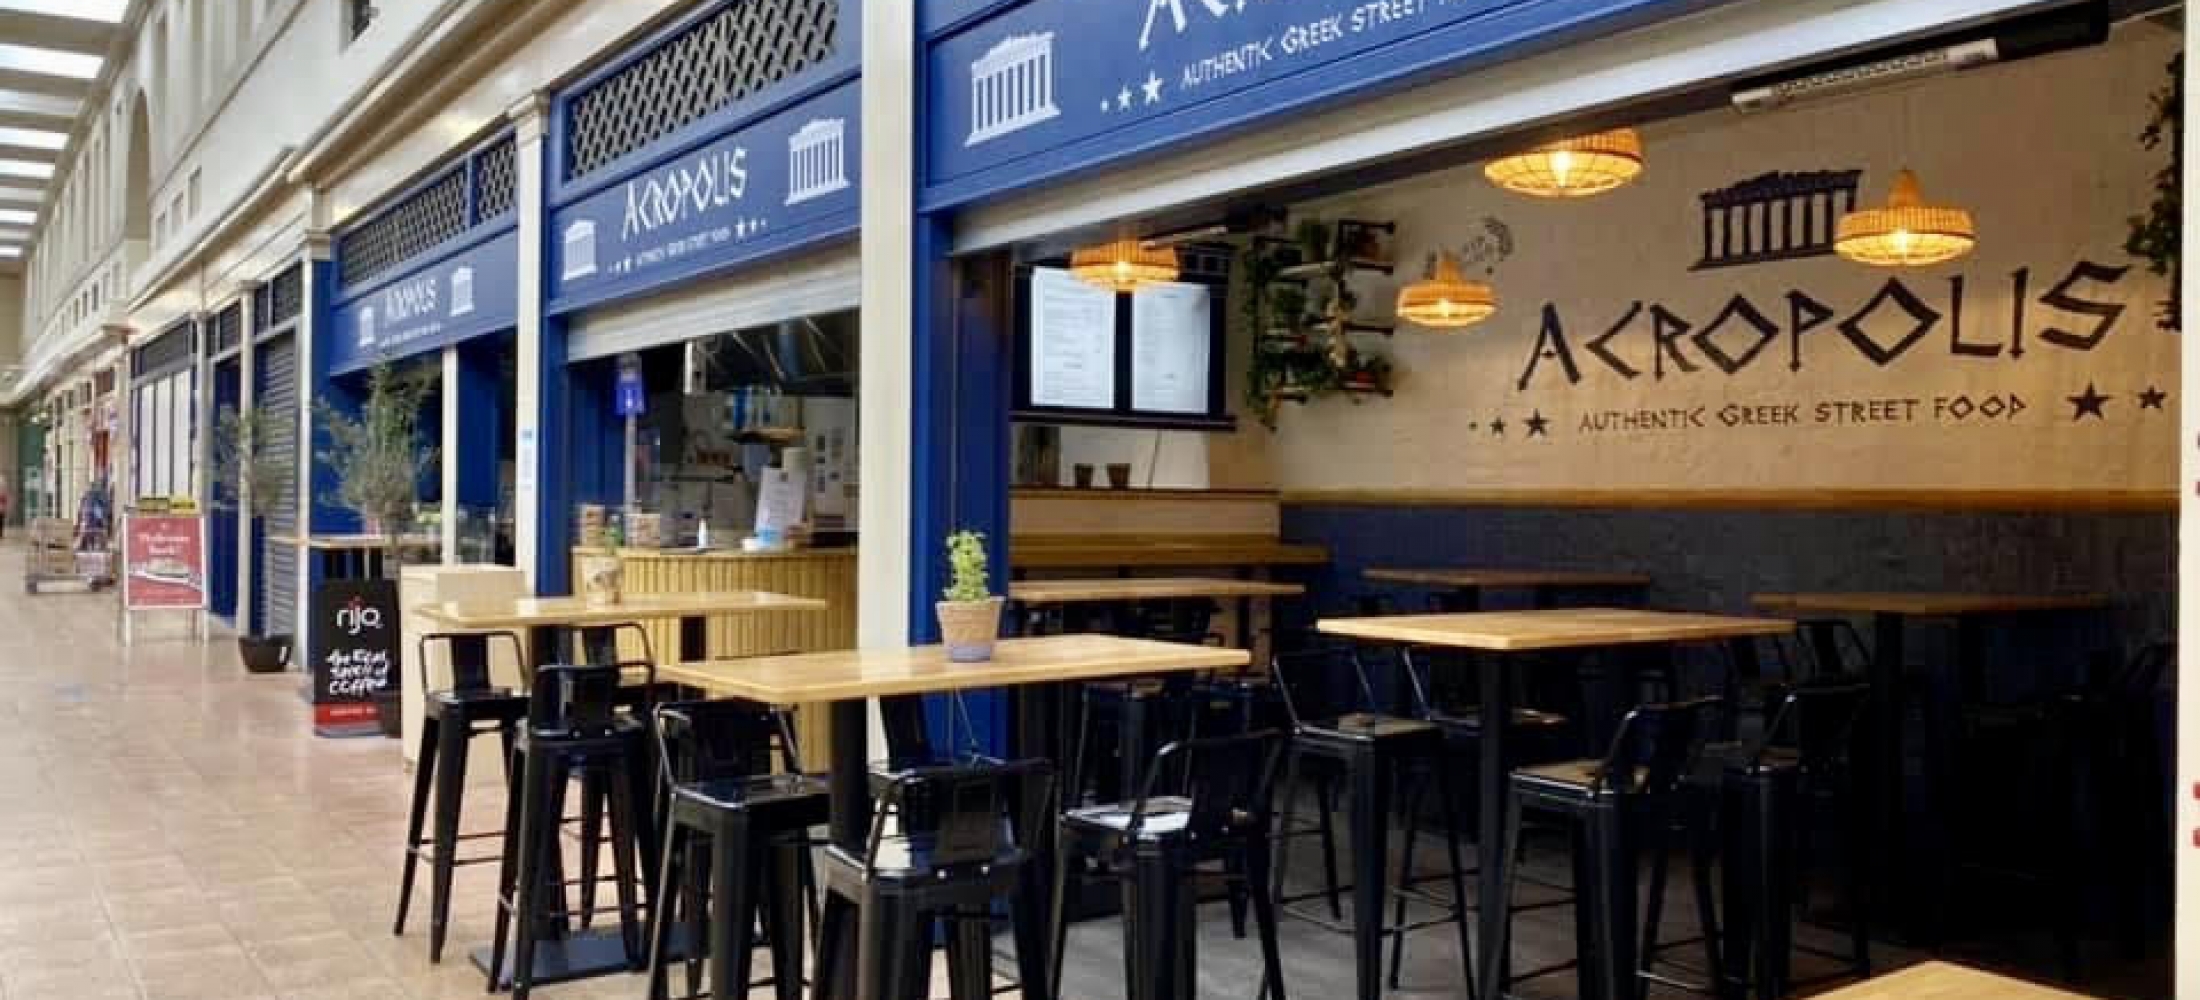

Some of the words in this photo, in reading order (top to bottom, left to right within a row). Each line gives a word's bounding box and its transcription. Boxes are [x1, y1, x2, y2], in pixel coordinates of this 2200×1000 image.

[1180, 36, 1273, 90] AUTHENTIC
[1280, 13, 1343, 54] GREEK
[622, 147, 748, 242] ACROPOLIS
[1517, 260, 2134, 392] ACROPOLIS
[1578, 405, 1706, 433] AUTHENTIC
[1716, 403, 1800, 427] GREEK
[1814, 399, 1920, 425] STREET
[1933, 394, 2027, 422] FOOD
